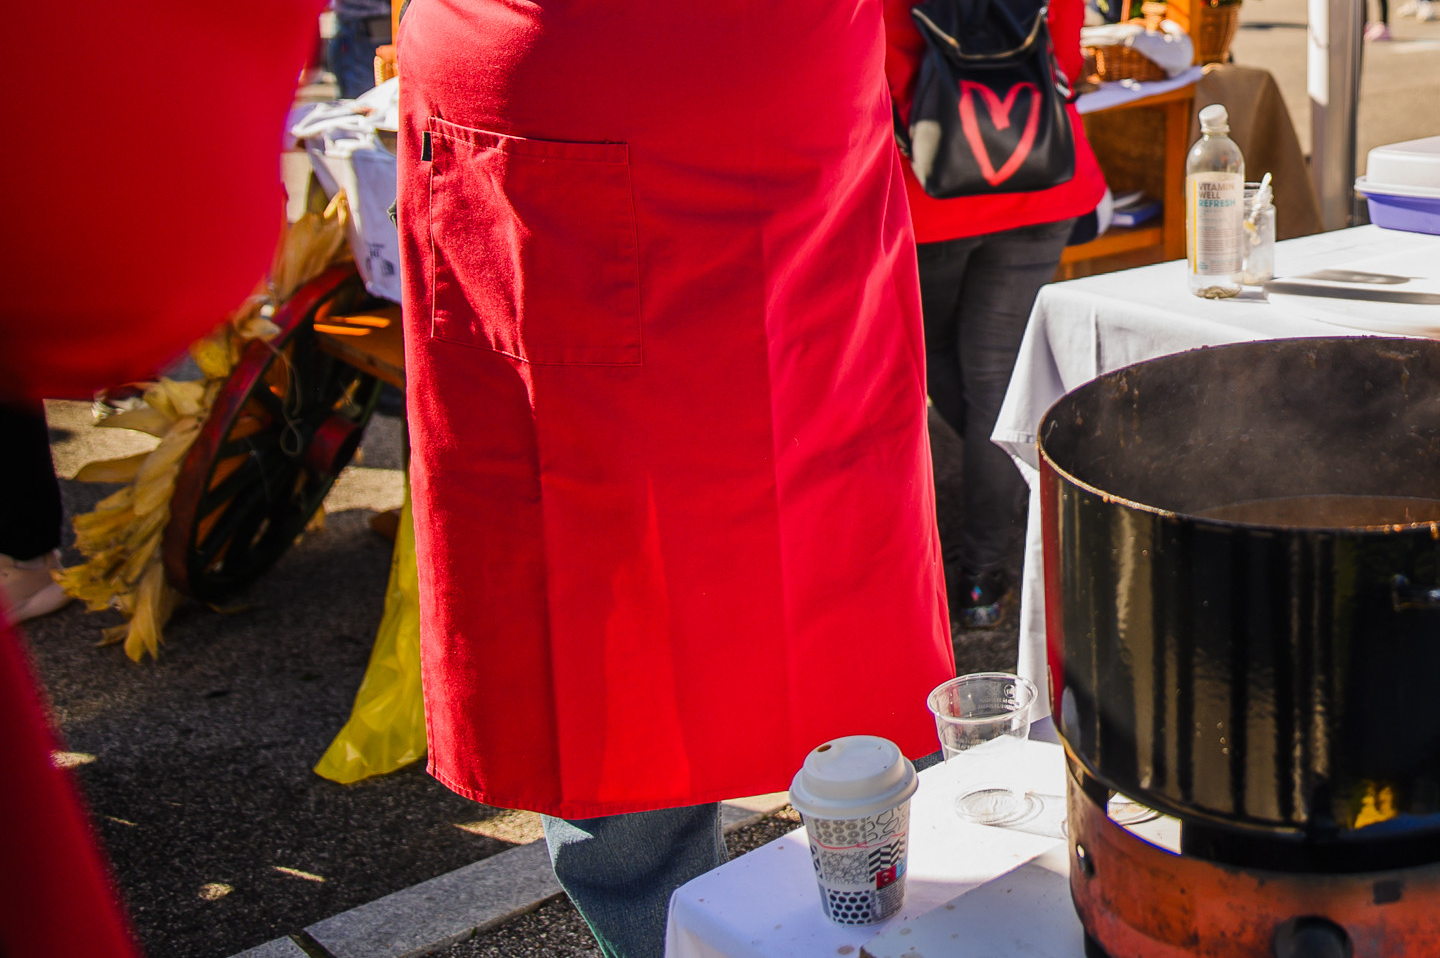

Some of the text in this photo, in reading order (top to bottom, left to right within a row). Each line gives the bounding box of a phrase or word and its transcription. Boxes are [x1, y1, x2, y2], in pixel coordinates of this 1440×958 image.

[1198, 183, 1235, 192] VITAMIN
[1198, 191, 1221, 200] WELL
[1199, 199, 1236, 208] REFRESH
